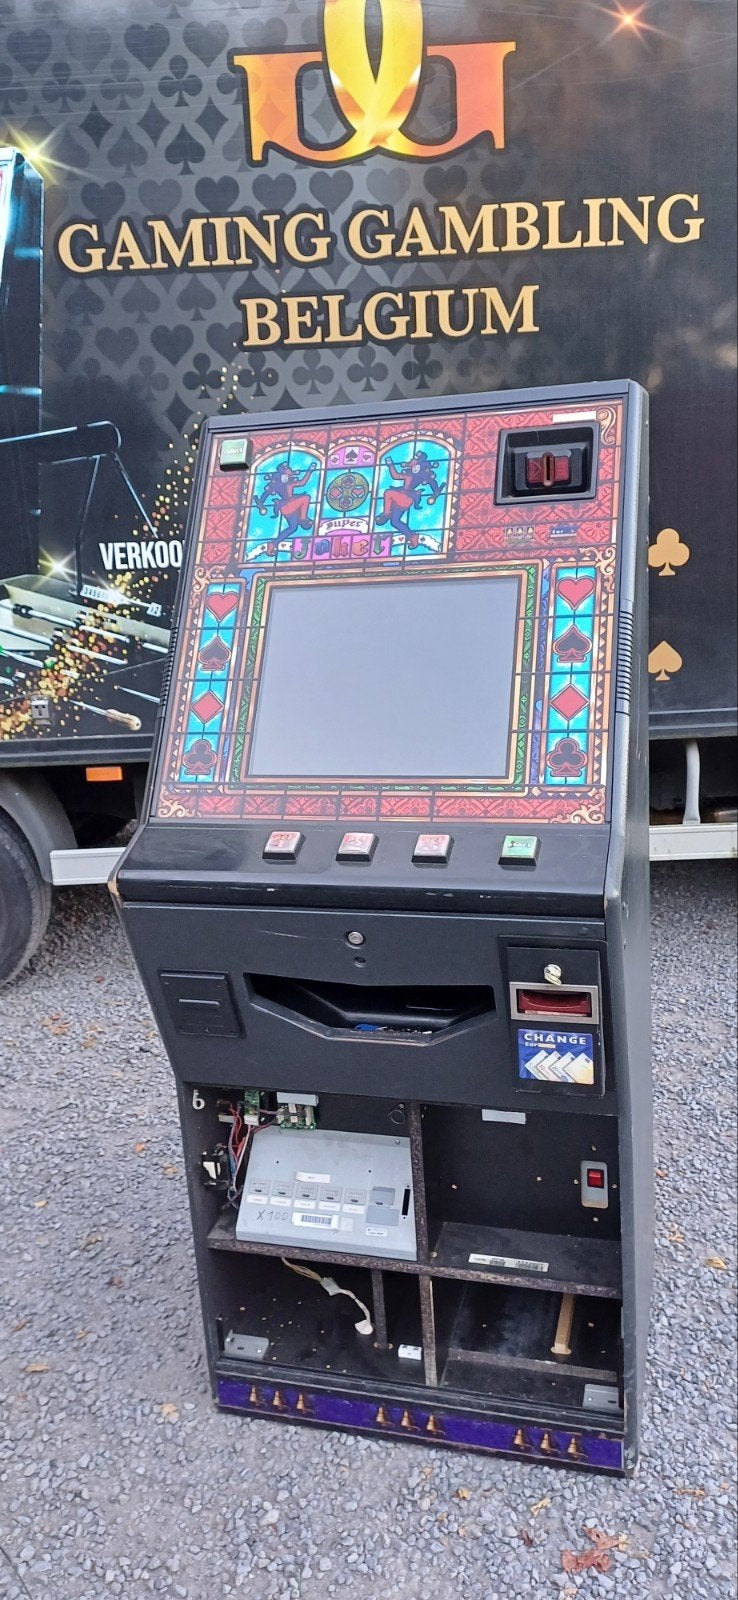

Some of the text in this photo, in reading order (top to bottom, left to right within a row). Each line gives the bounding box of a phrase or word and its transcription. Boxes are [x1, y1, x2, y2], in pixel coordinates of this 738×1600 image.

[58, 194, 705, 274] GAMING GAMBLING
[240, 285, 540, 347] BELGIUM
[99, 540, 186, 570] VERKOO
[524, 1033, 586, 1045] CHANGE
[192, 1089, 205, 1110] 6
